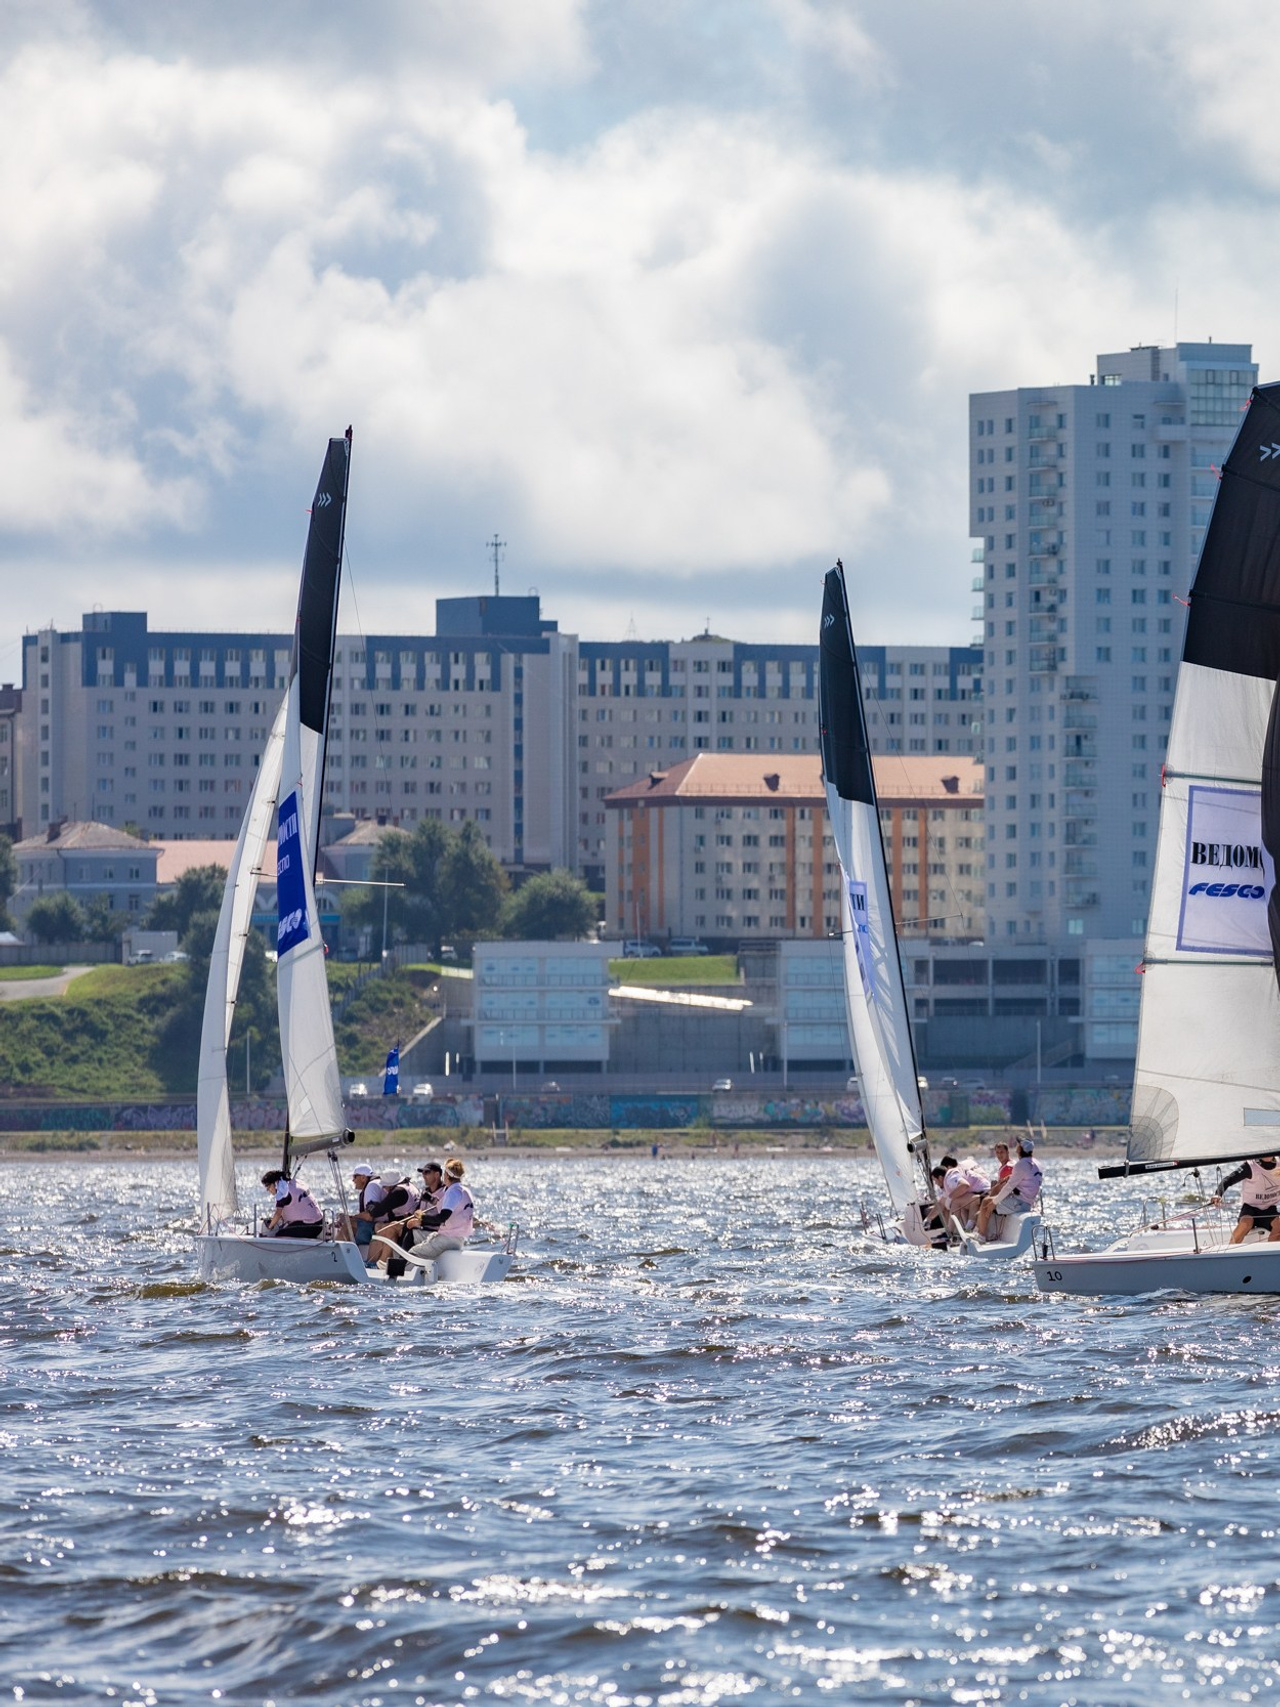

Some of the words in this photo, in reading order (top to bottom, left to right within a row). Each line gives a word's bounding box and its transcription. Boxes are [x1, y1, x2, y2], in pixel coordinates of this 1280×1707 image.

[1190, 841, 1265, 871] ВЕДОМ
[1188, 882, 1265, 899] FESCO
[1047, 1270, 1063, 1281] 10
